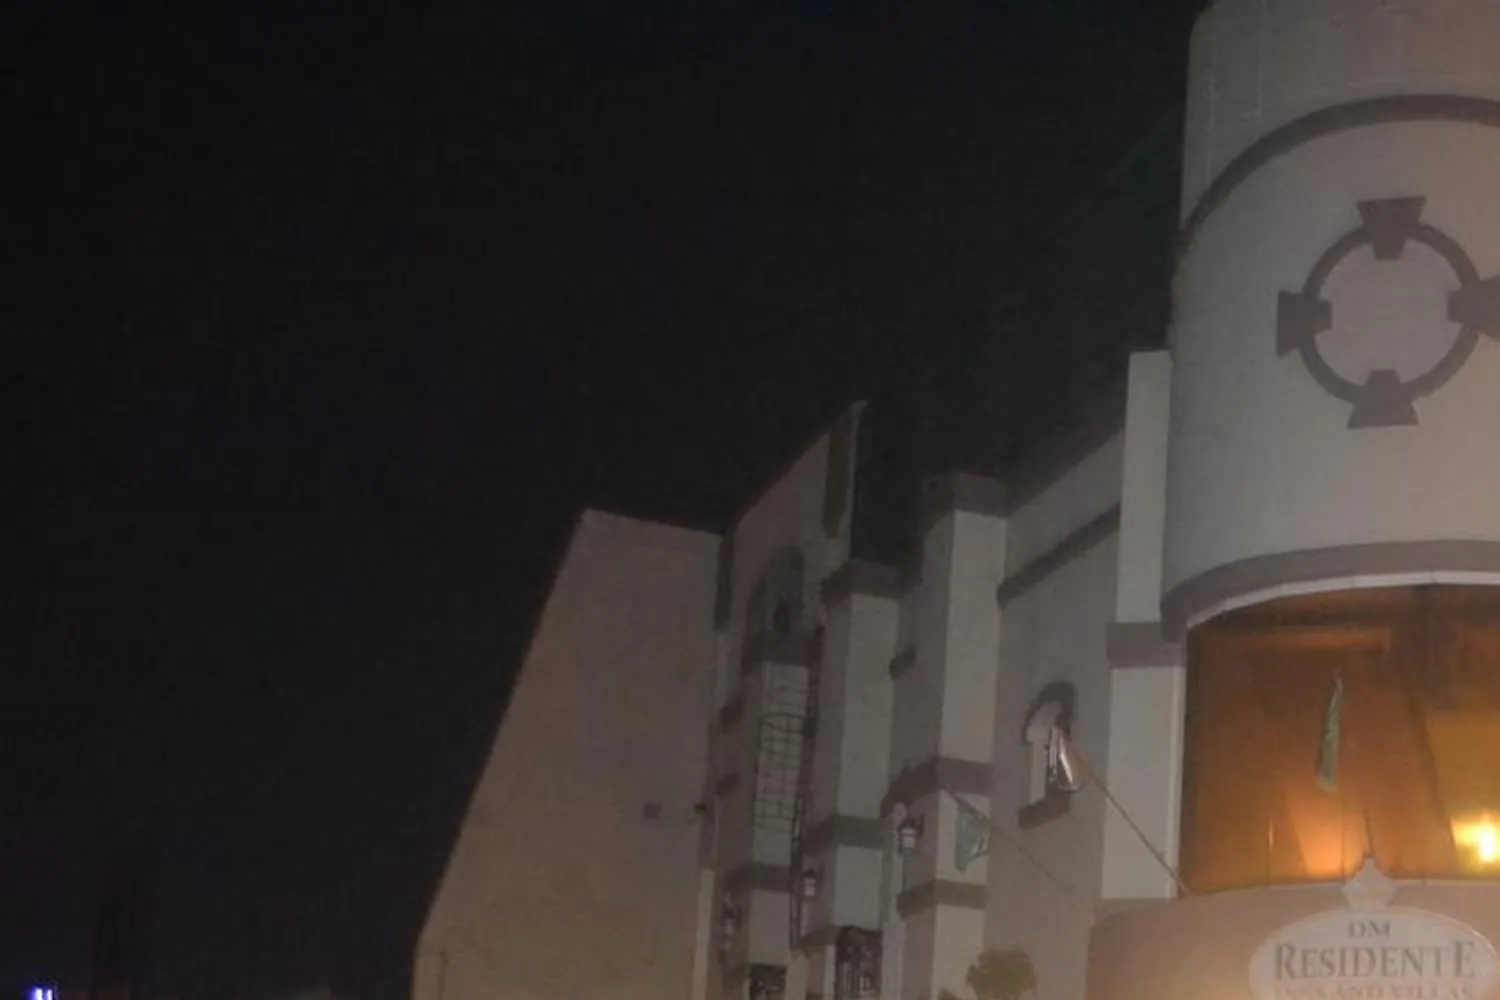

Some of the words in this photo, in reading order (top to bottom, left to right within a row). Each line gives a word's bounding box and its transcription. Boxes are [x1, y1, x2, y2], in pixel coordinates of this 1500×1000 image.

[1348, 919, 1390, 939] DM
[1274, 940, 1475, 981] RESIDENTE
[1337, 983, 1385, 1000] AND
[1391, 982, 1476, 1000] VILLAS
